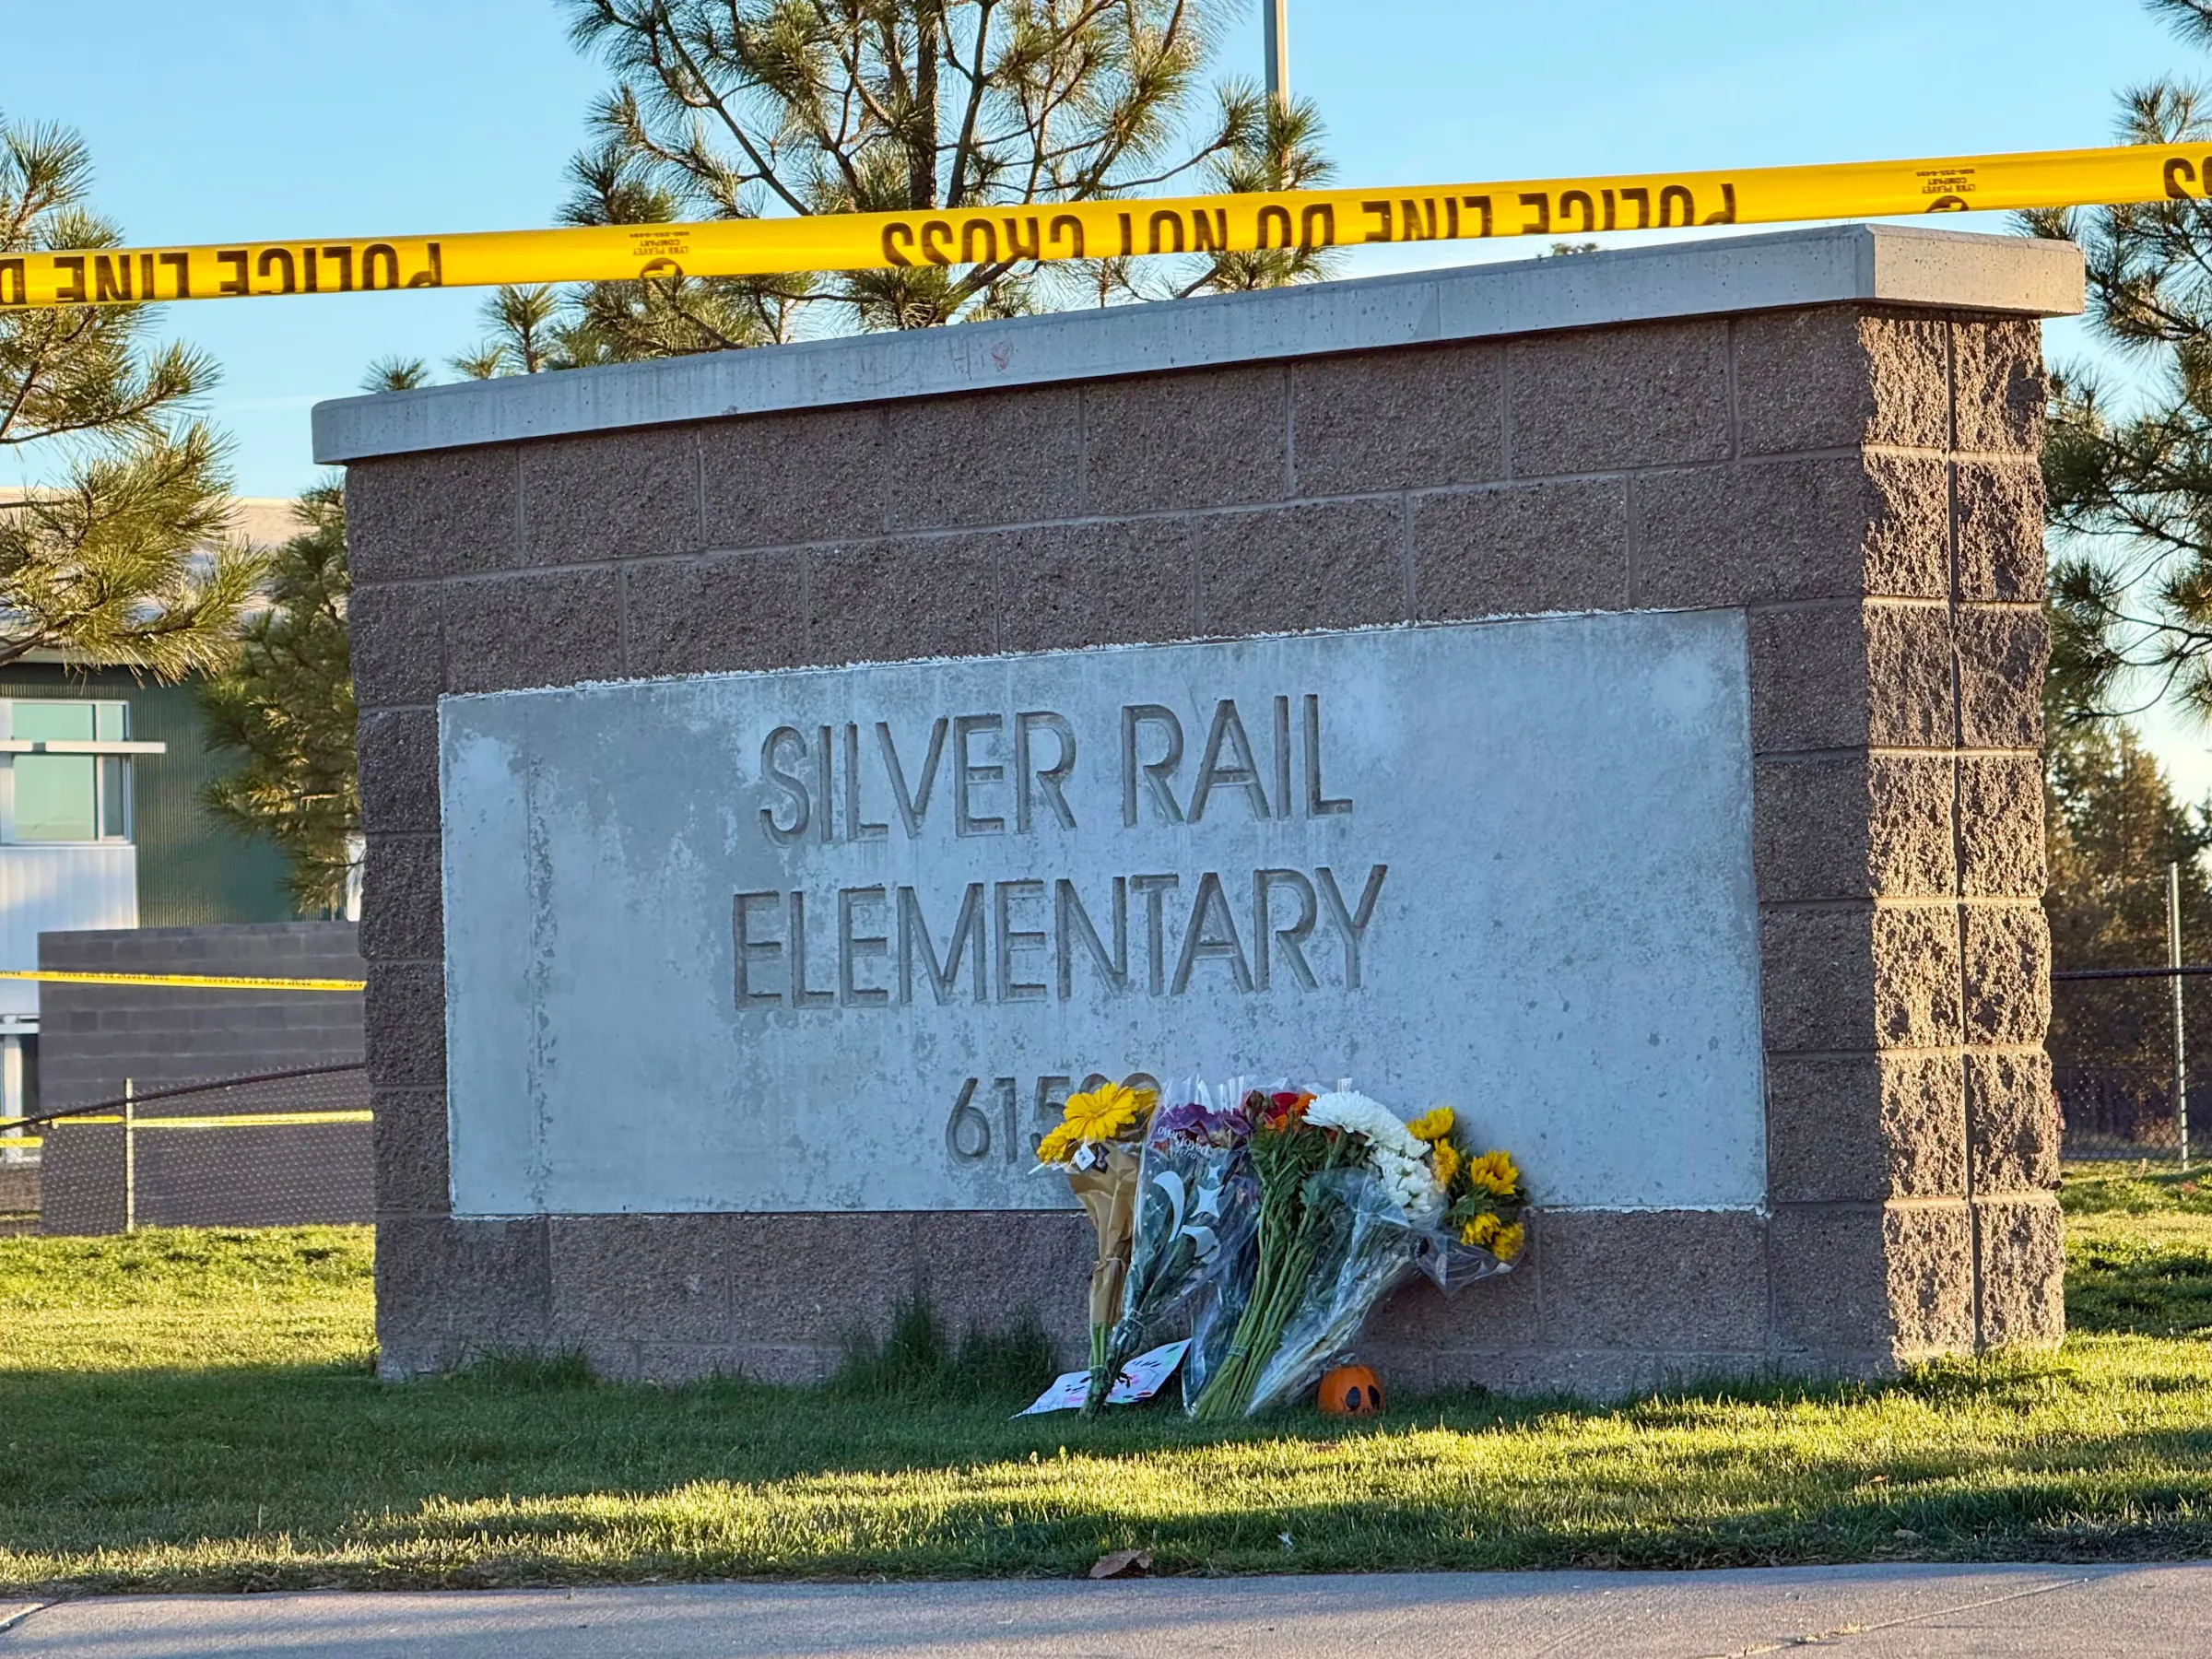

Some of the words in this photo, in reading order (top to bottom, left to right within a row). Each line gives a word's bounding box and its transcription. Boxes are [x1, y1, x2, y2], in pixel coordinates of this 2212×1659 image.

[1118, 208, 1227, 255] NOT
[1257, 203, 1335, 250] DO
[1360, 194, 1492, 243] LINE
[1518, 183, 1735, 236] POLICE
[881, 214, 1084, 266] CROSS
[55, 252, 189, 303] LINE
[218, 241, 442, 295] POLICE
[759, 711, 1077, 847] SILVER
[1123, 694, 1353, 828] RAIL
[734, 864, 1387, 1012] ELEMENTARY
[946, 1073, 1161, 1169] 615
